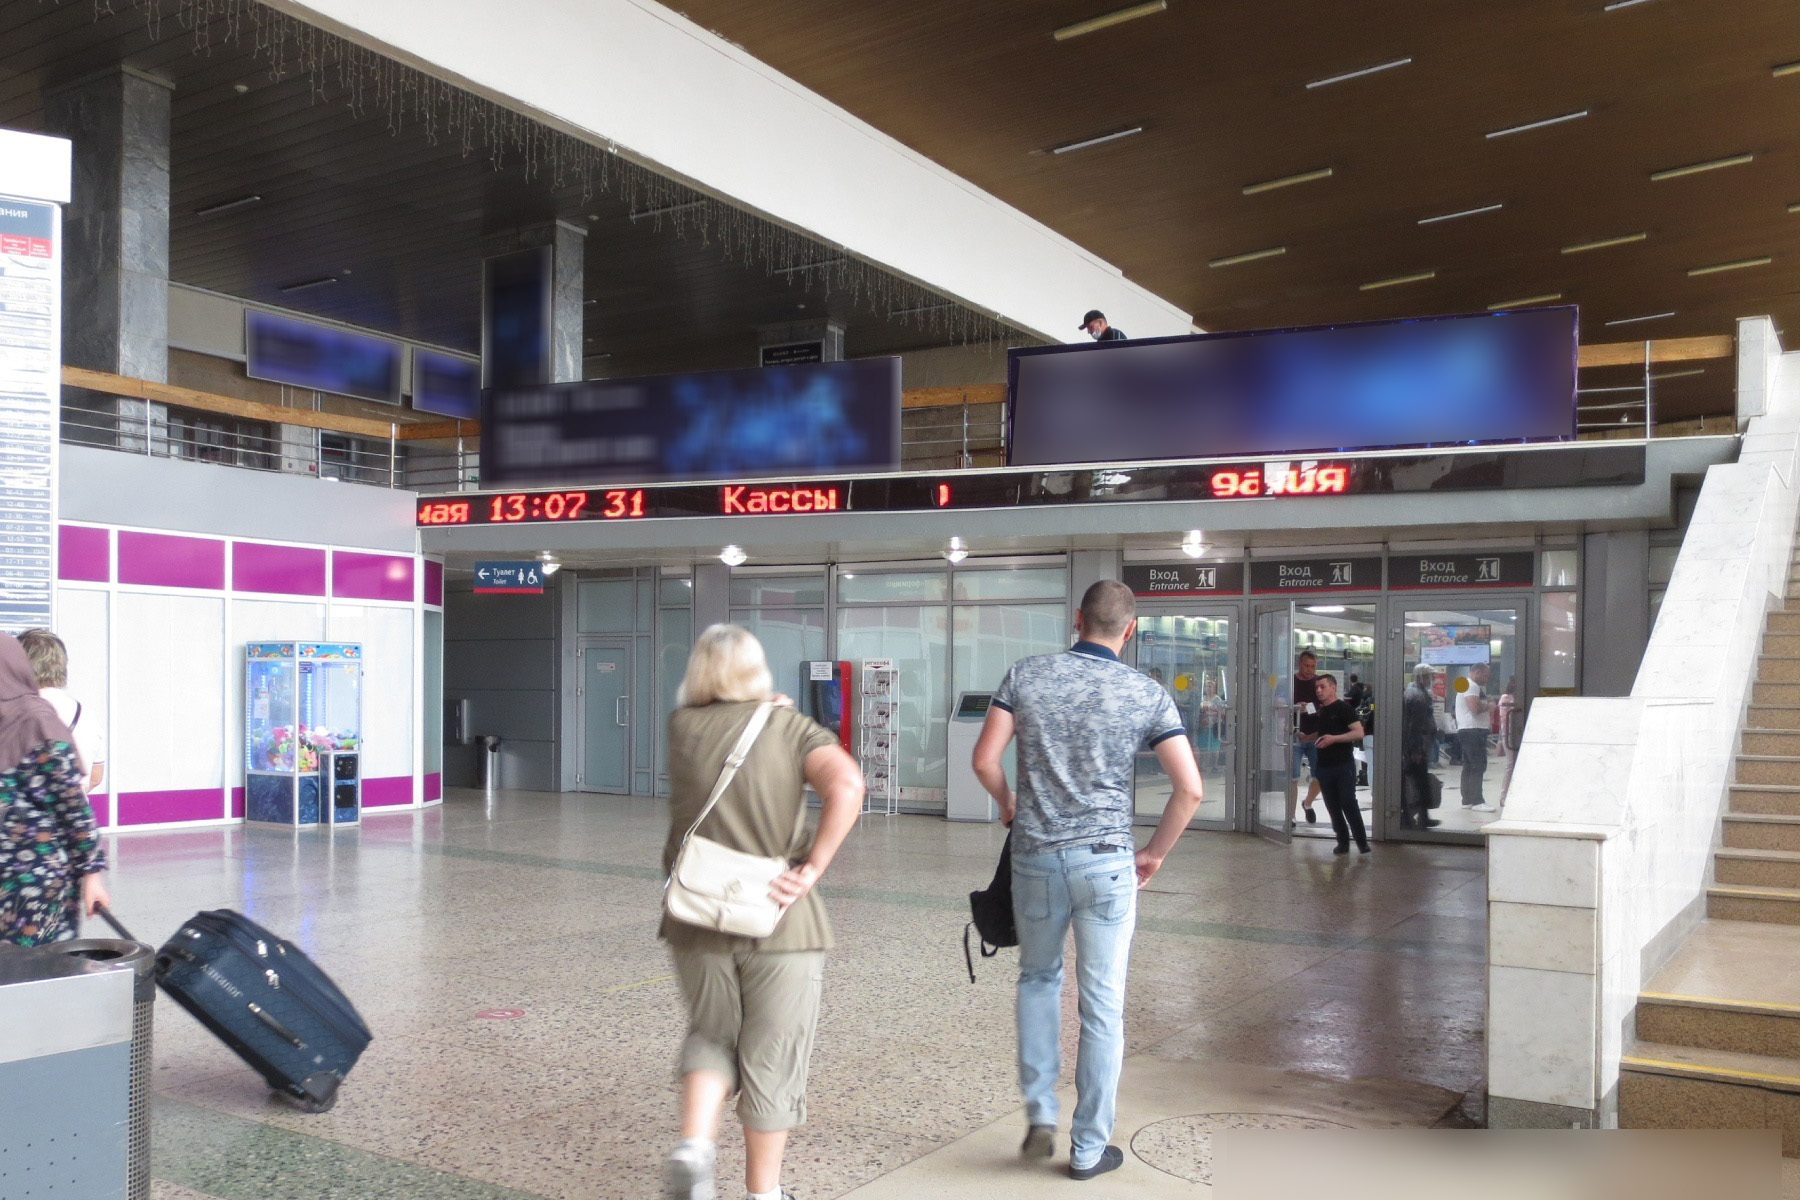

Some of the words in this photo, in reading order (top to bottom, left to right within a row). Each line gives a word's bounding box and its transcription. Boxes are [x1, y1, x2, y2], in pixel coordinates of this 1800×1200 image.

[490, 492, 587, 521] 13:07
[603, 490, 645, 518] 31
[723, 486, 837, 514] Кассы
[1279, 564, 1312, 577] Вход
[1419, 559, 1456, 573] Вход
[492, 568, 516, 577] Туалет
[1149, 569, 1180, 581] Вход
[1419, 573, 1469, 583] Entrance
[1149, 581, 1190, 591] Entrance
[1279, 577, 1324, 587] Entrance
[201, 963, 244, 998] JOURNEY
